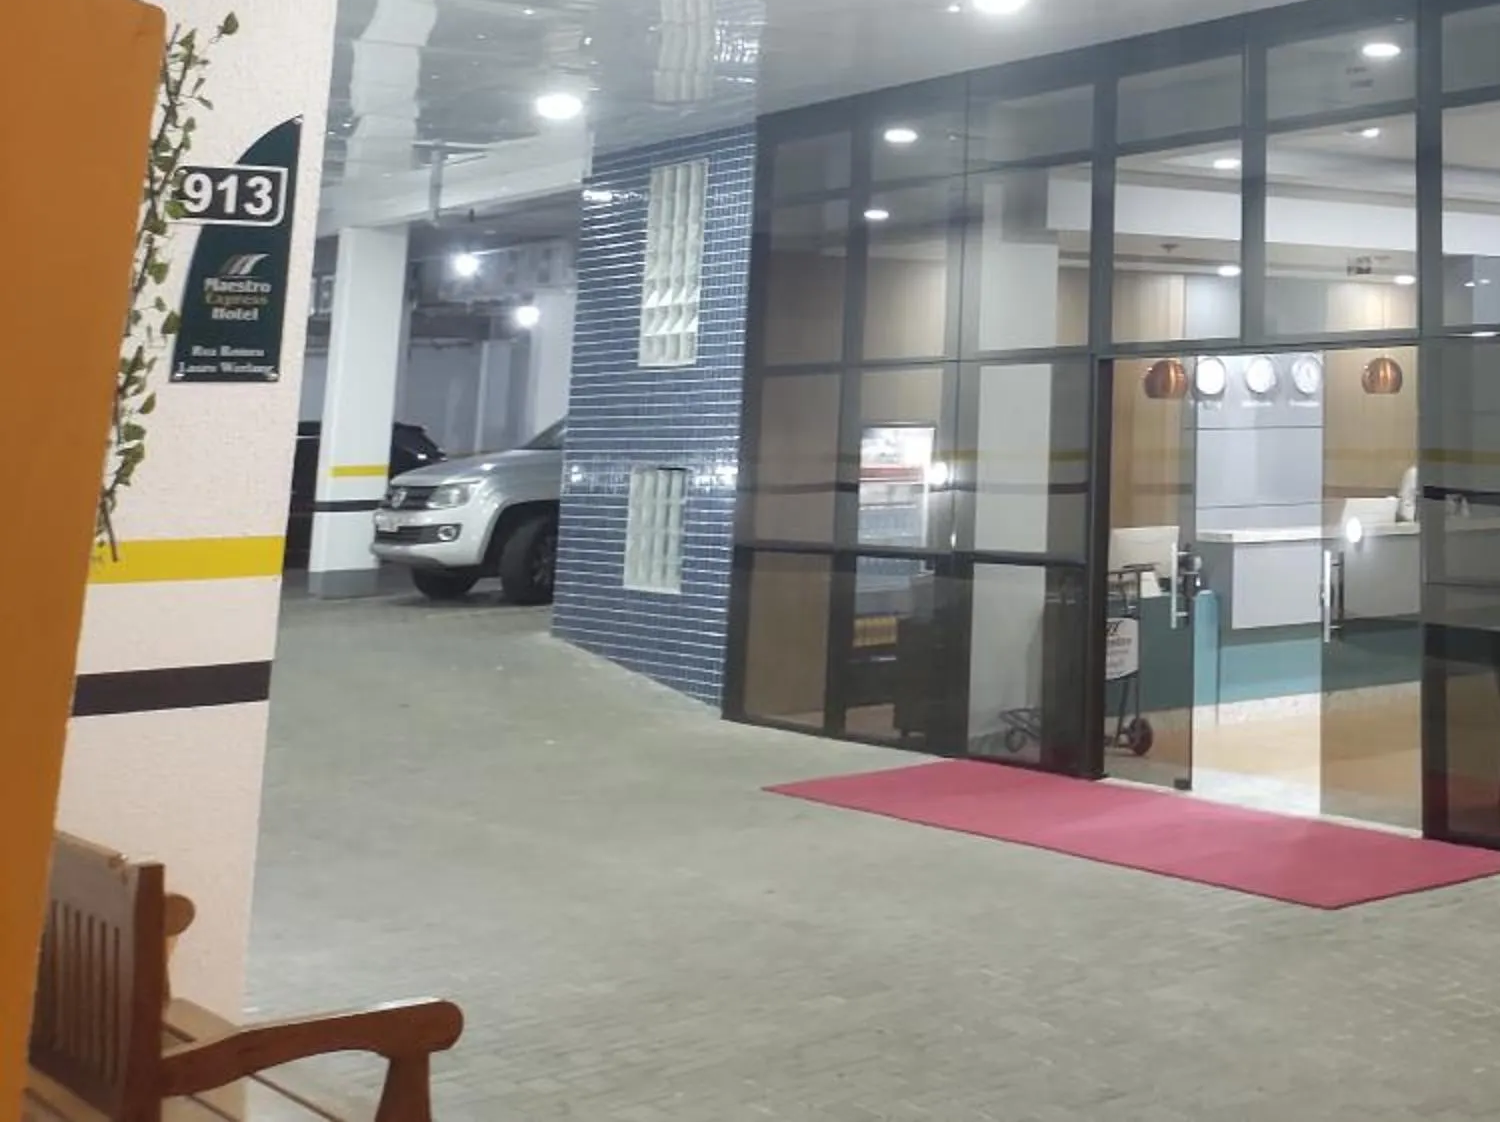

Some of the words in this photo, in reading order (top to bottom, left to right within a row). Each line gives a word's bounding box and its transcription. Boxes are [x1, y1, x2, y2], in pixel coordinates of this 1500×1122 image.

[183, 173, 273, 216] 913
[203, 277, 272, 293] Maestro
[211, 307, 259, 321] Hotel
